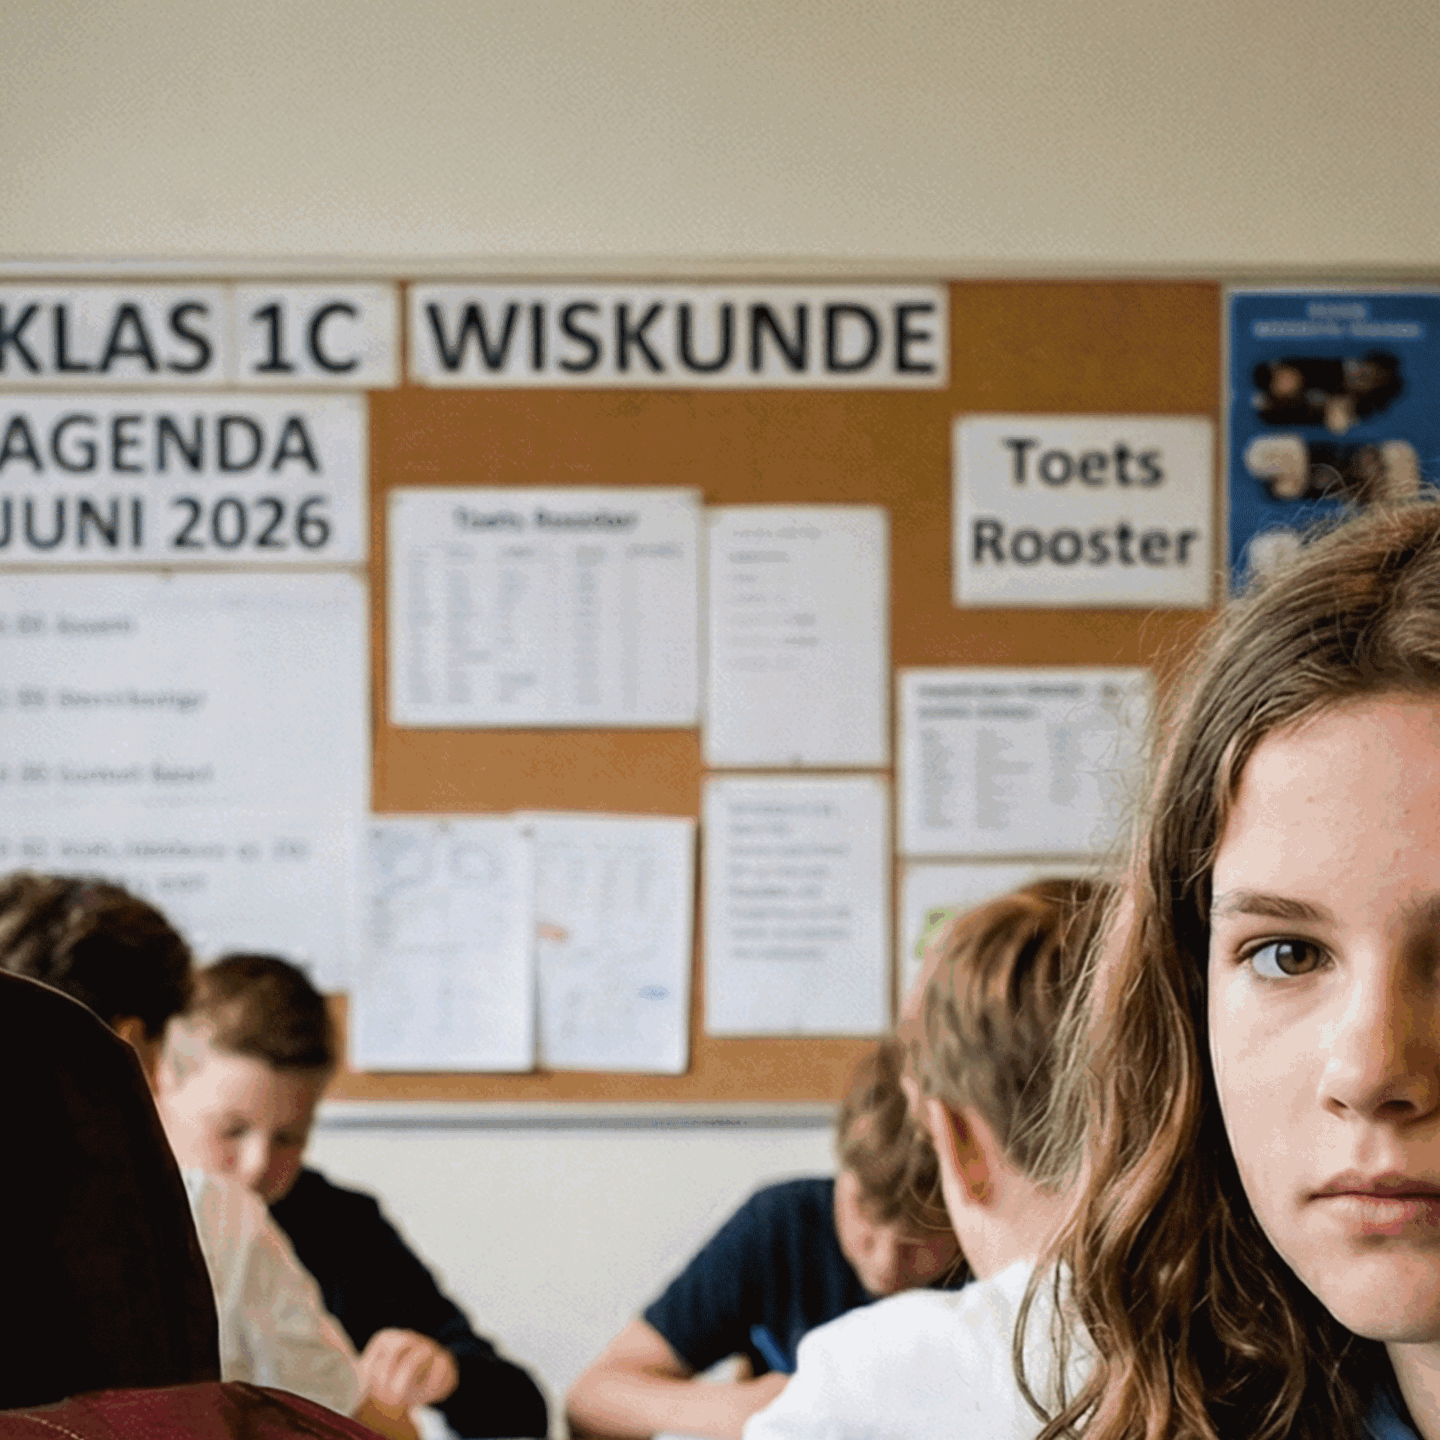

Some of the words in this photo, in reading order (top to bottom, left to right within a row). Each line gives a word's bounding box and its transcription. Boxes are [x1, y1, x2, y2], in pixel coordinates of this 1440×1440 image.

[0, 301, 214, 375] KLAS
[253, 301, 359, 375] 1C
[426, 301, 936, 376] WISKUNDE
[0, 413, 320, 474] AGENDA
[1003, 437, 1165, 488] Toets
[0, 497, 143, 549] JUNI
[172, 496, 332, 550] 2026
[971, 518, 1198, 568] Rooster
